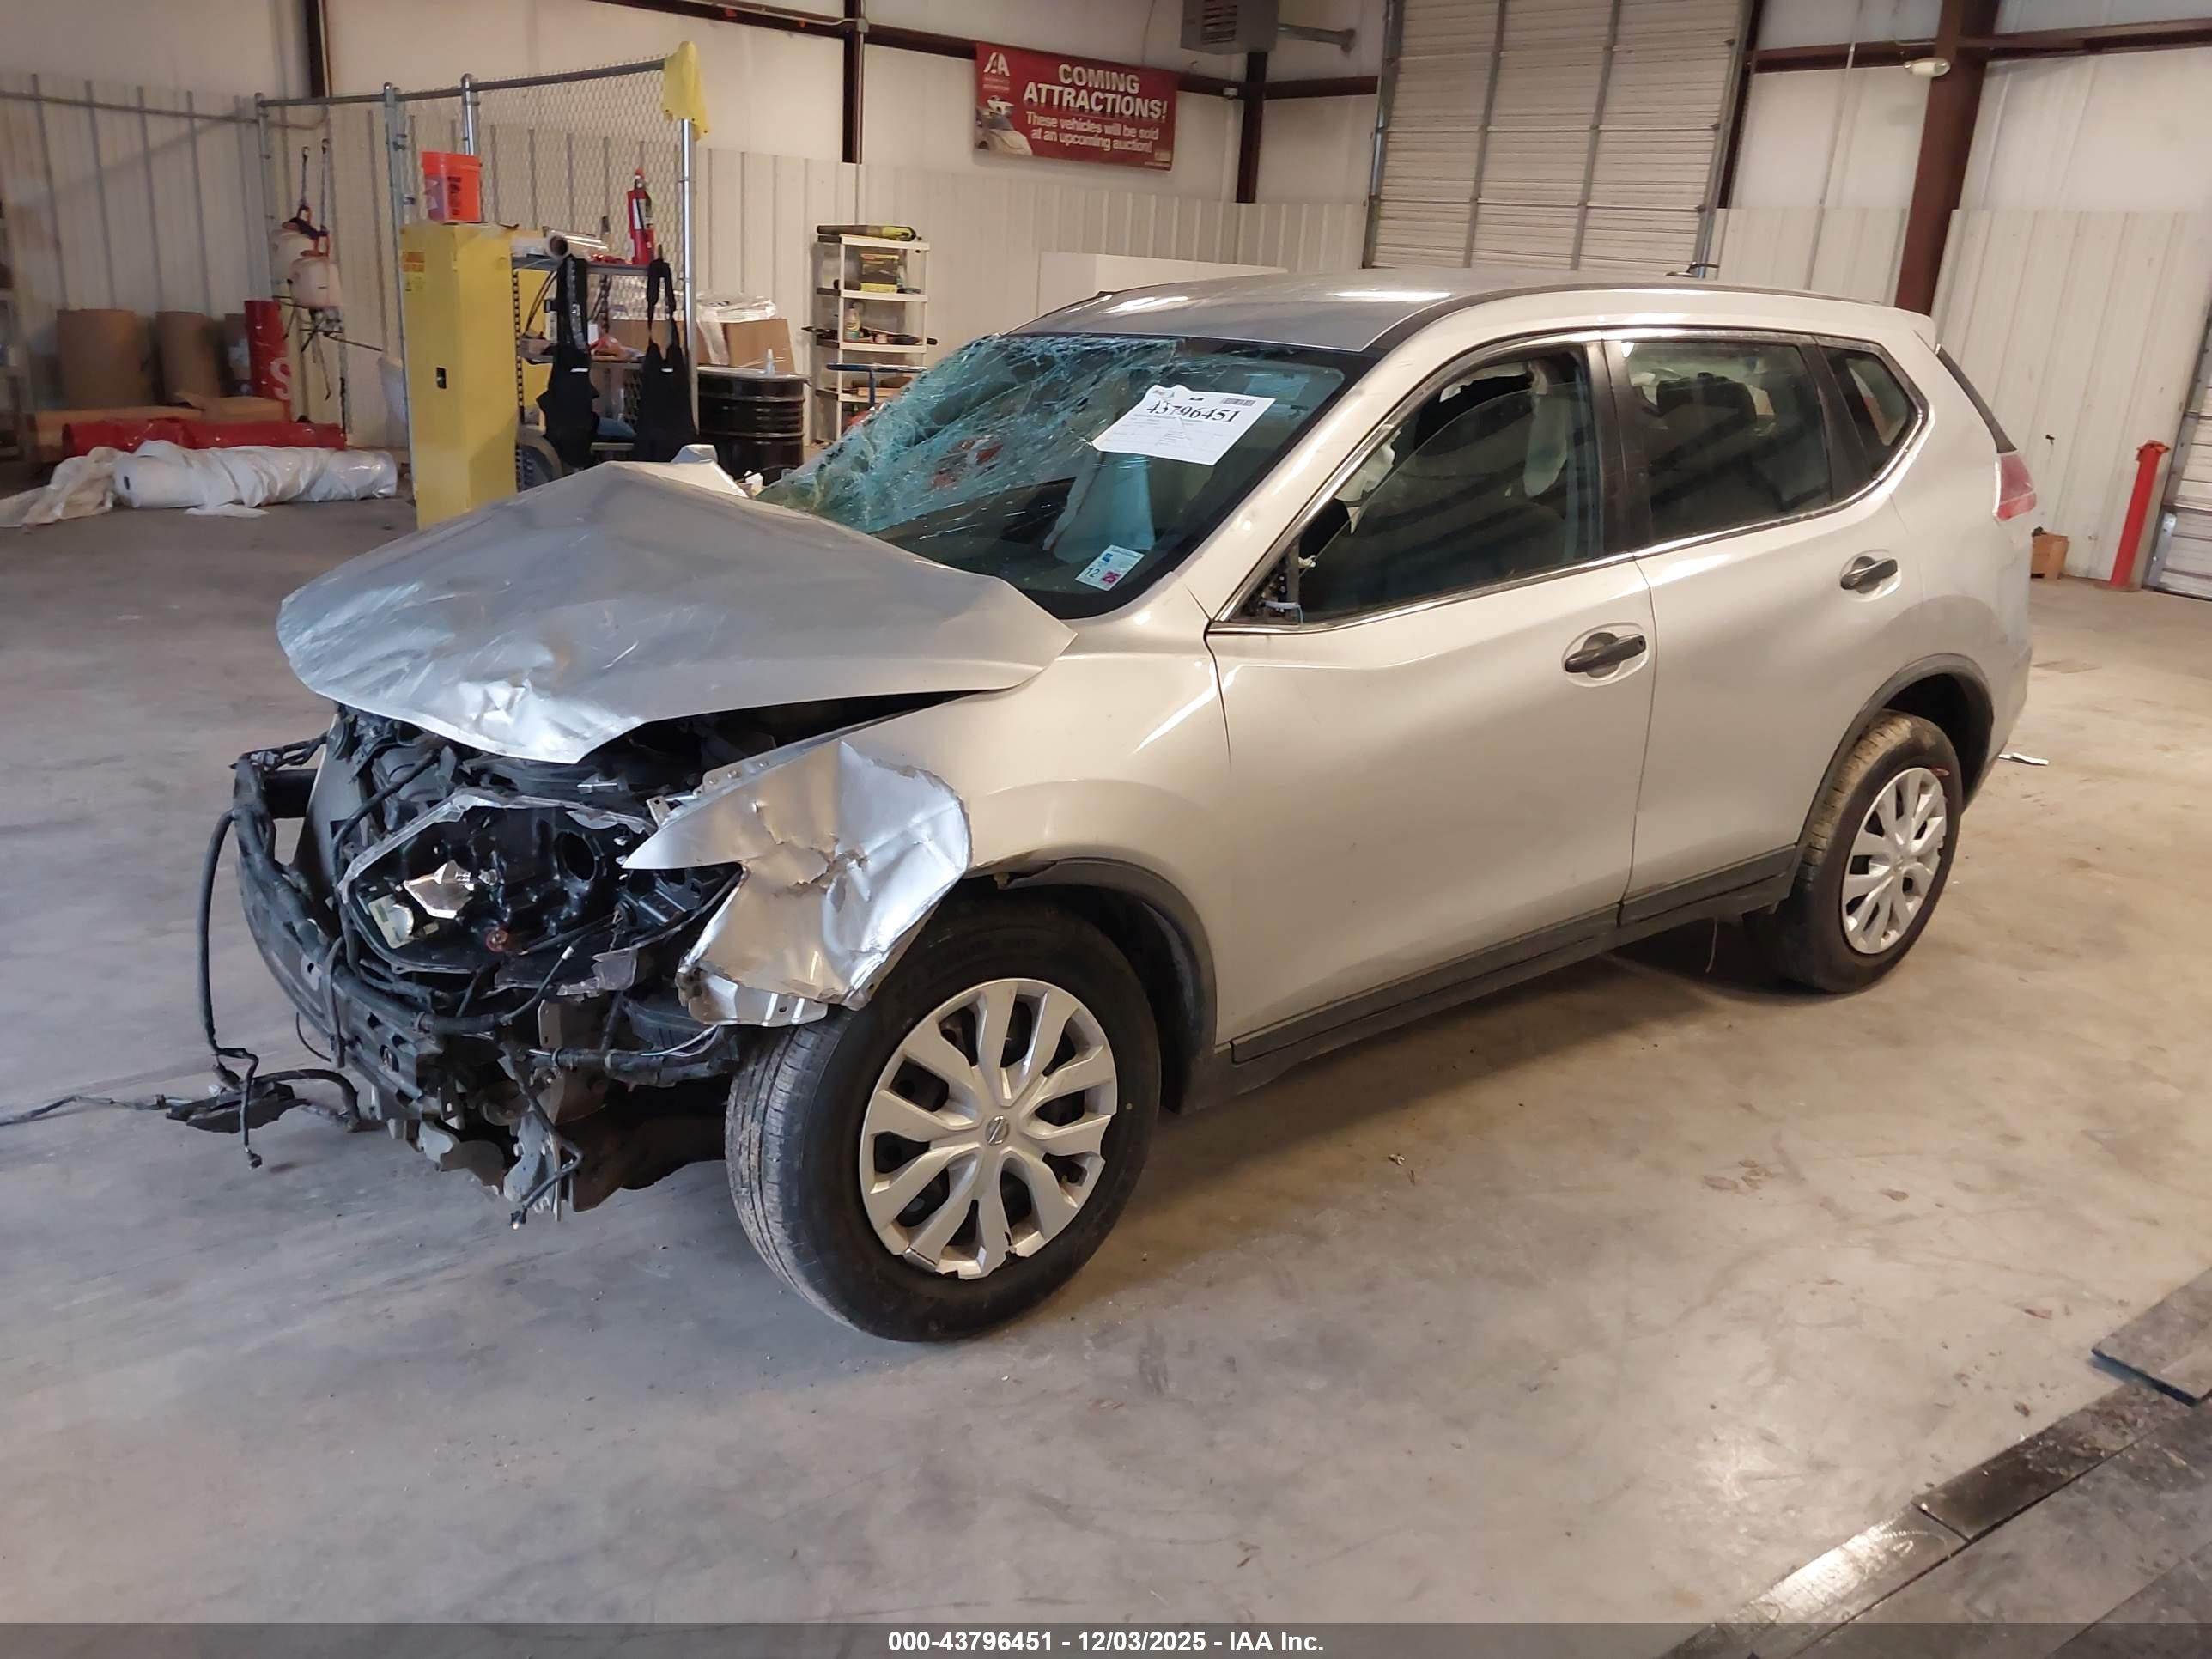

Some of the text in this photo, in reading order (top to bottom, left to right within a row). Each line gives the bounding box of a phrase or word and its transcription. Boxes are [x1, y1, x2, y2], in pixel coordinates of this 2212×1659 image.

[1058, 64, 1140, 94] COMING
[1024, 82, 1168, 120] ATTRACTIONS!
[1025, 111, 1159, 141] These vehicles will be sold
[1030, 128, 1042, 140] at
[1043, 130, 1058, 142] an
[1059, 132, 1111, 152] upcoming
[1146, 400, 1241, 422] 43796451
[1086, 568, 1100, 577] 12
